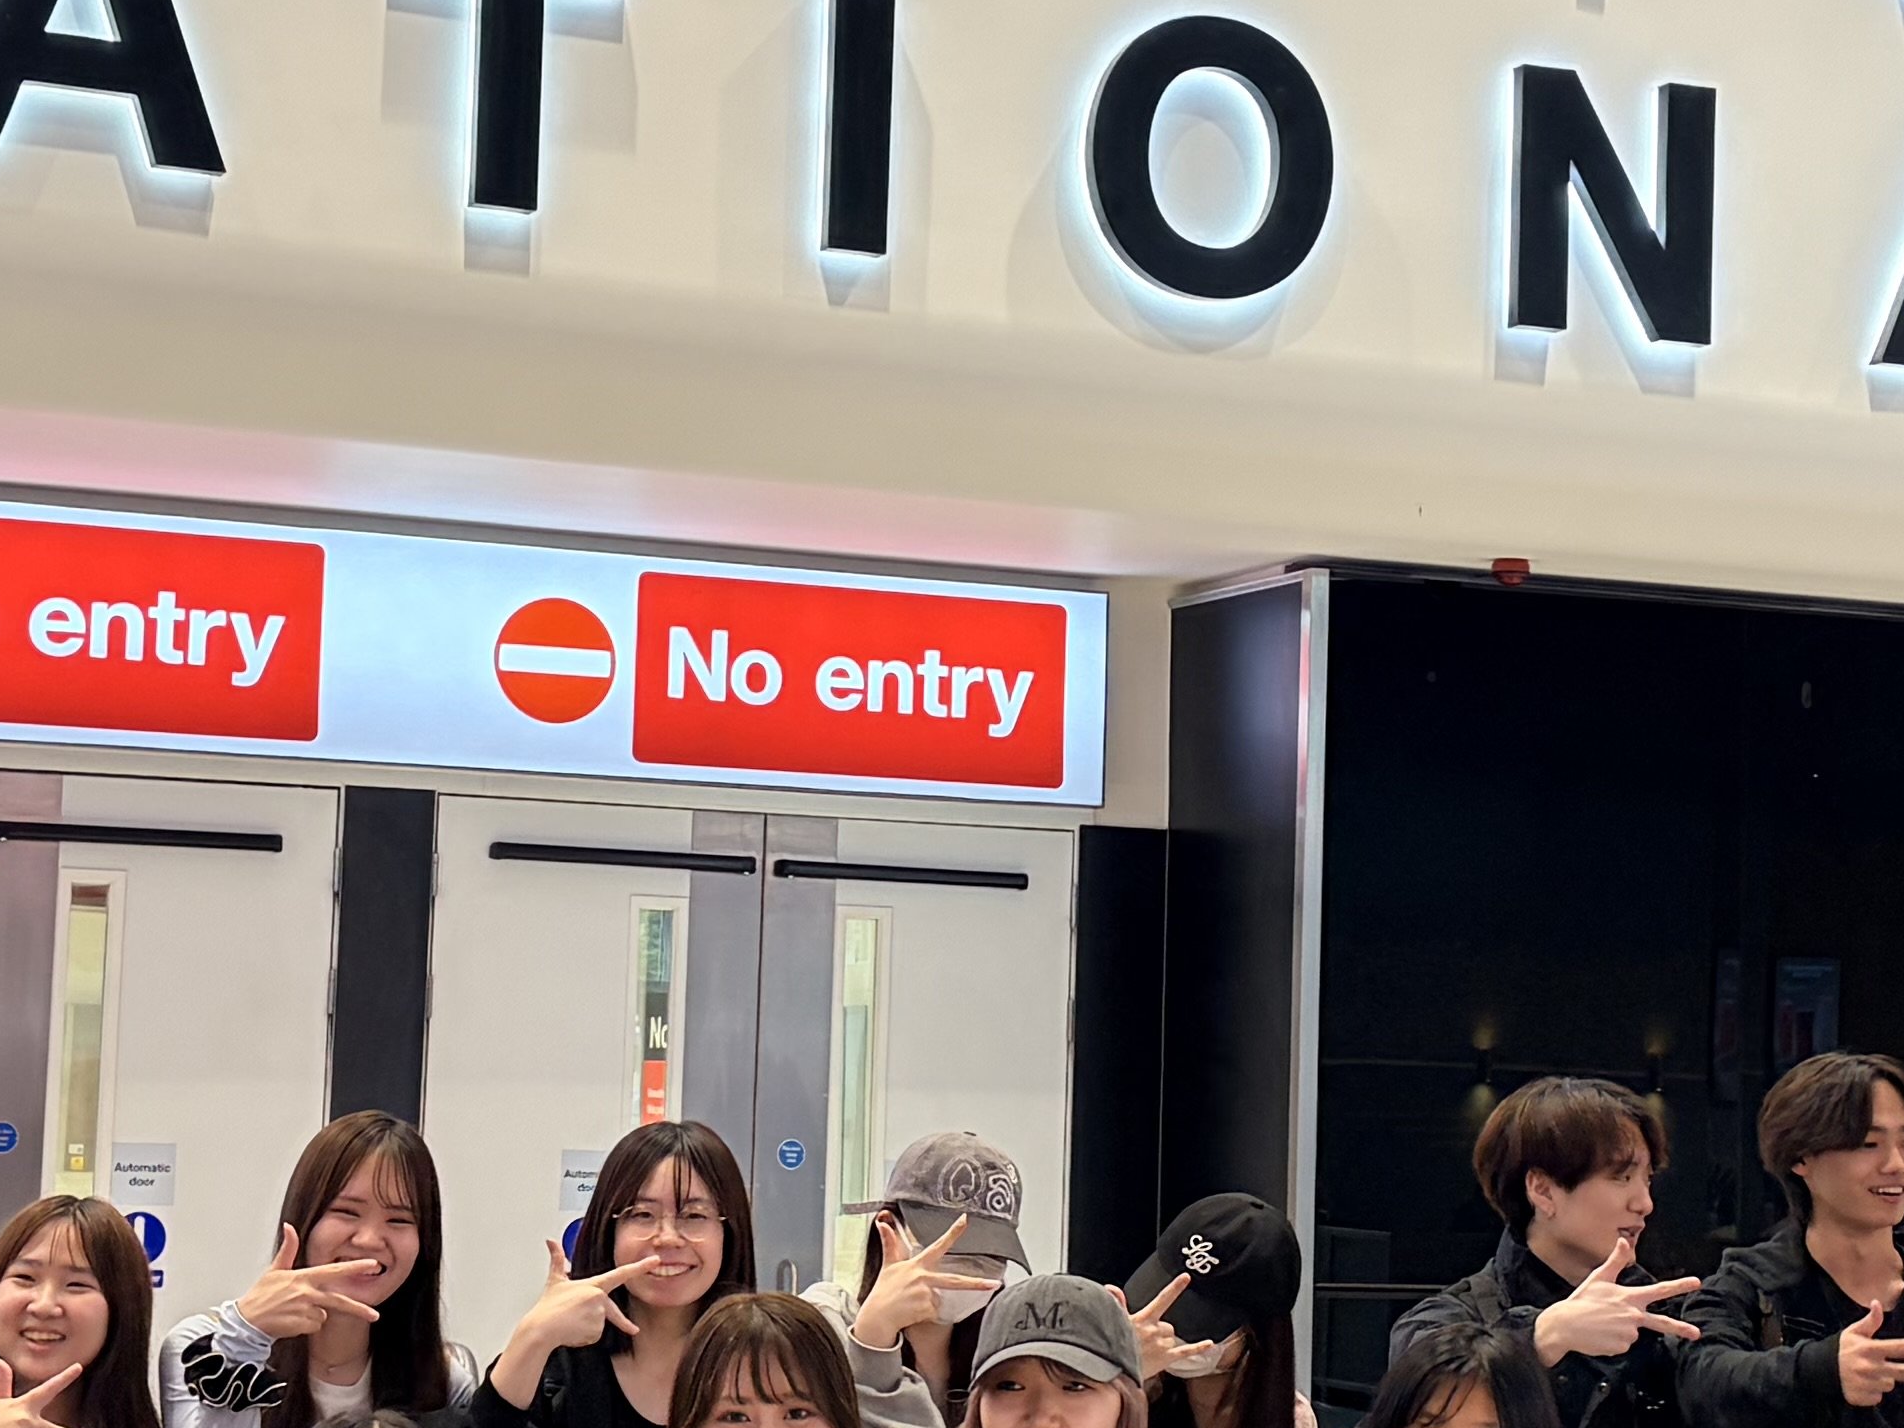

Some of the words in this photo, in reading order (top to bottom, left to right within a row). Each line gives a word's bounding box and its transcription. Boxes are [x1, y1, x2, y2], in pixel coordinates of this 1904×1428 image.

[27, 590, 287, 688] entry
[666, 625, 783, 706] No
[814, 649, 1035, 738] entry
[113, 1162, 171, 1173] Automatic
[128, 1175, 155, 1187] door
